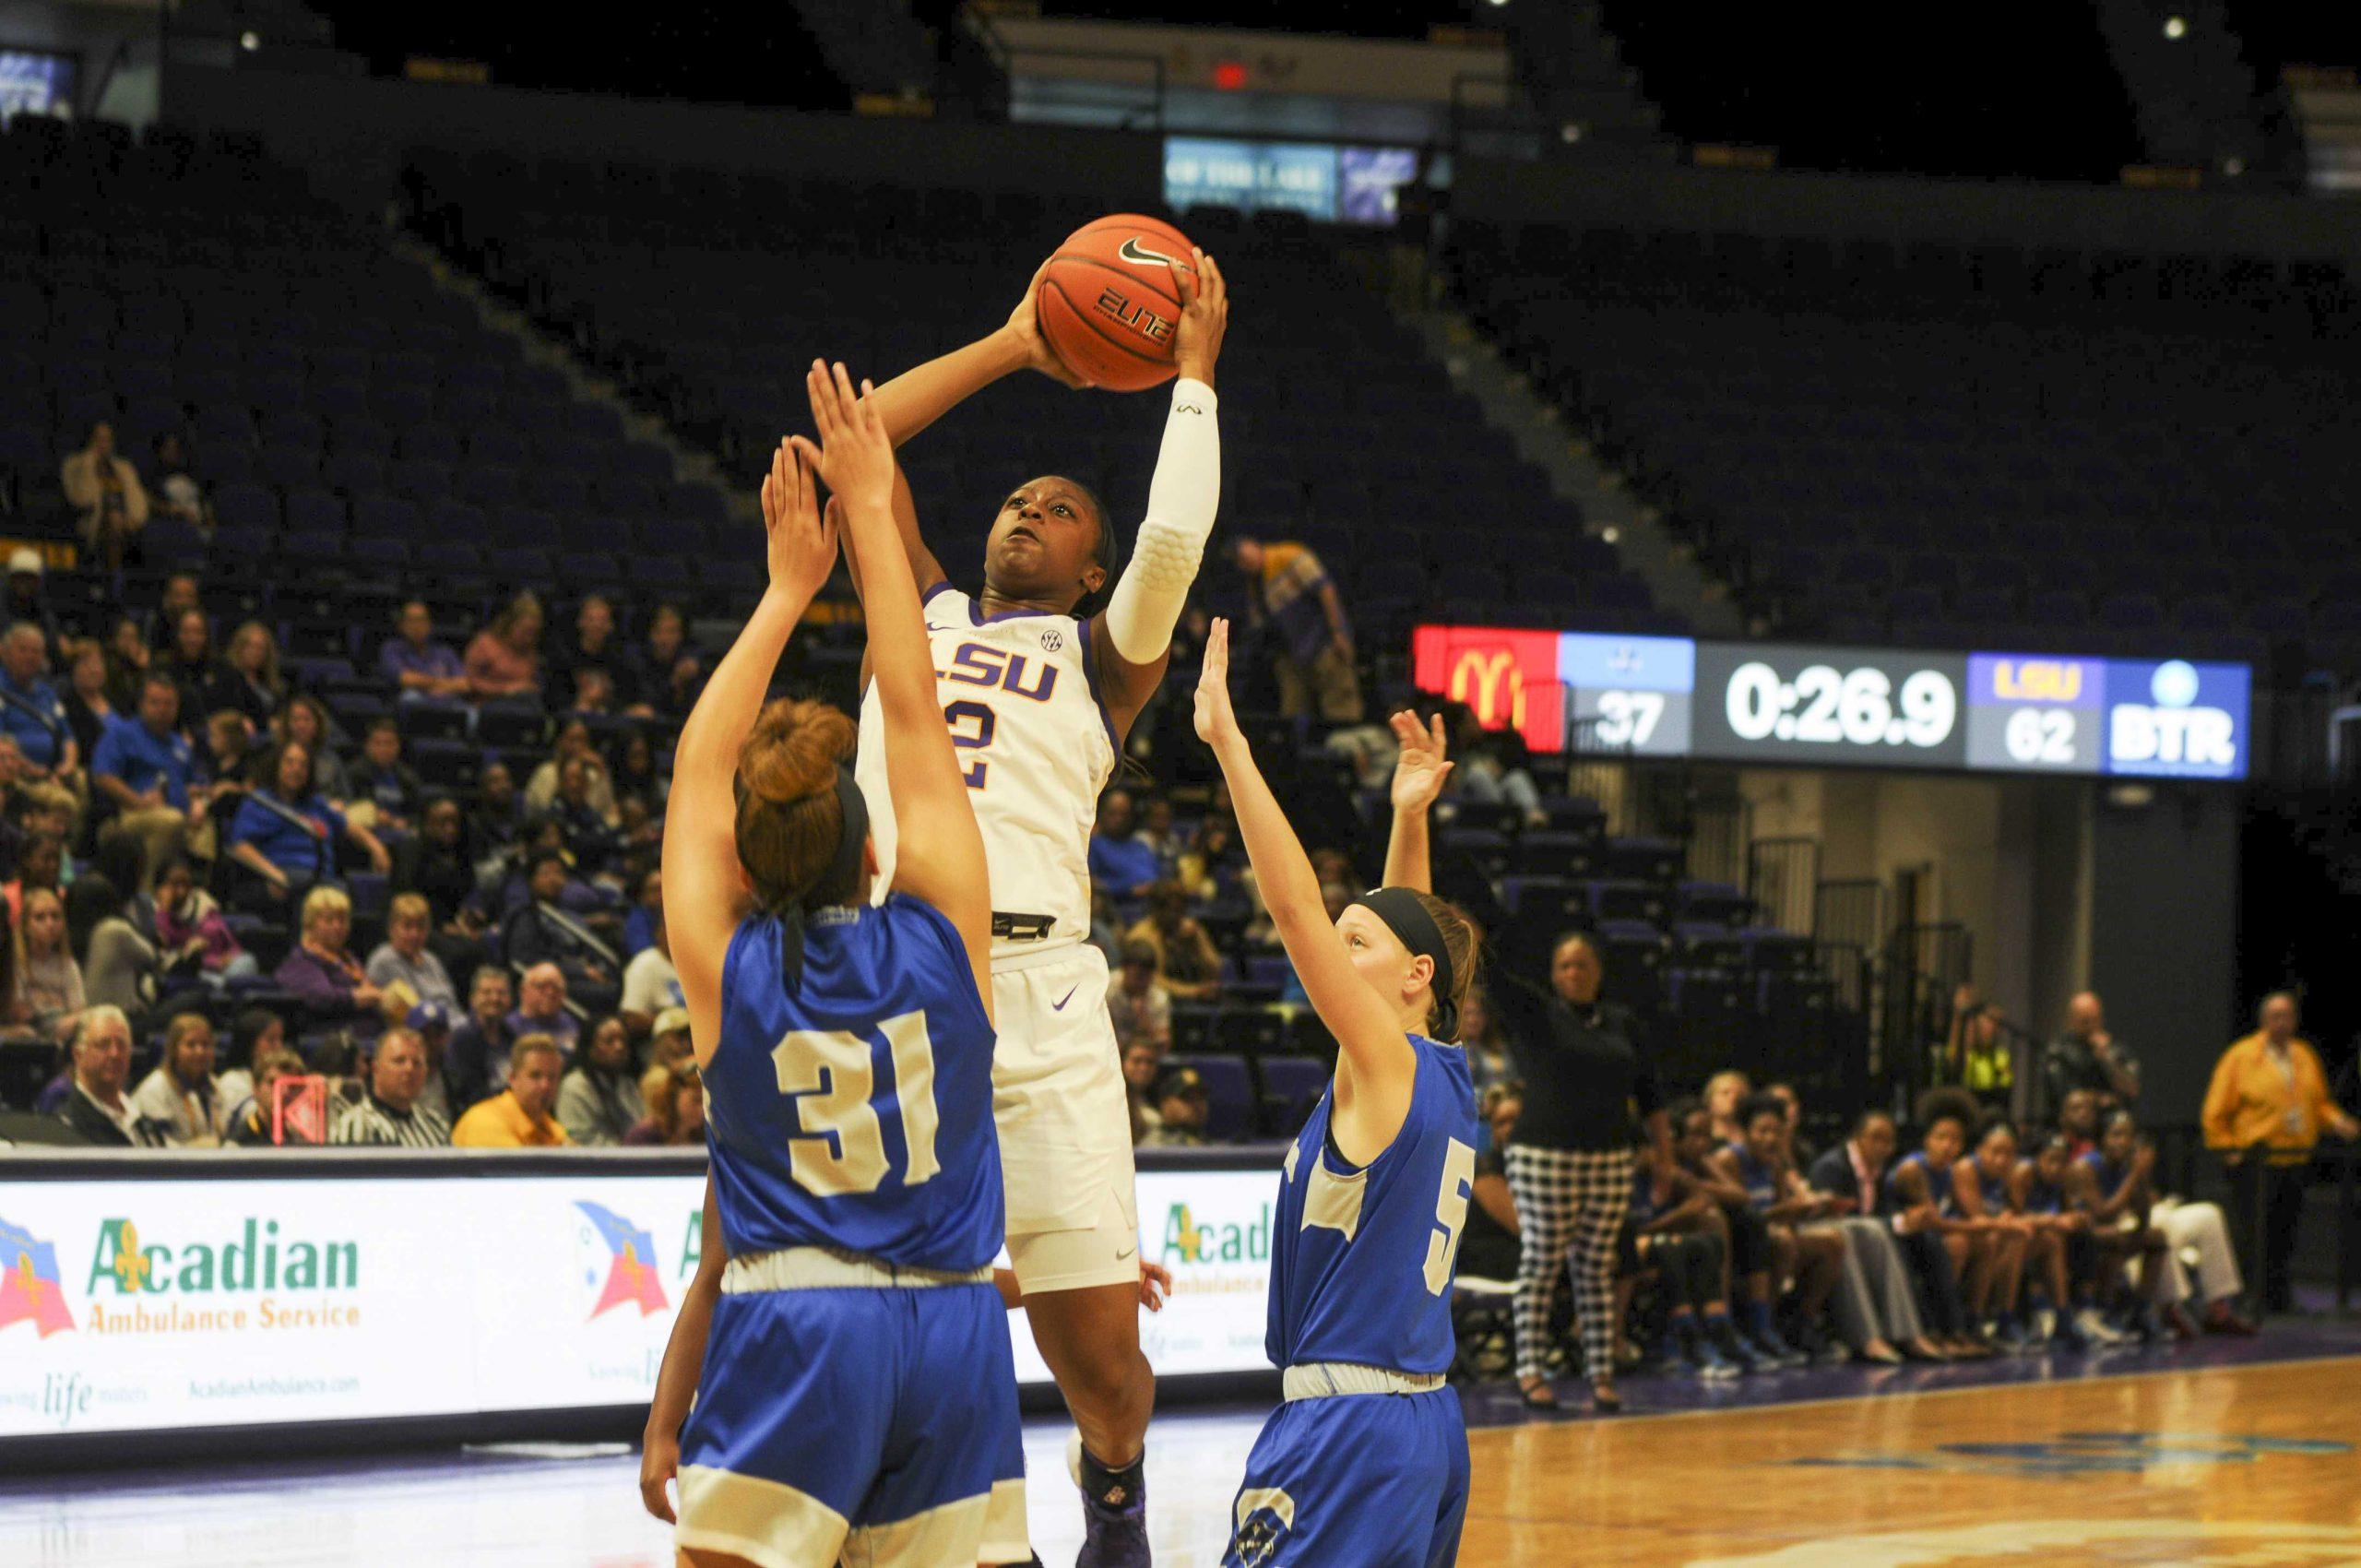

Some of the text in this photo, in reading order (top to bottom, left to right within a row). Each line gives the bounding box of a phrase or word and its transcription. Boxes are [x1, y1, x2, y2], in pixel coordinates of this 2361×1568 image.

[1097, 287, 1175, 343] ELITE
[931, 638, 1060, 704] SU
[1994, 659, 2082, 701] LSU
[1596, 689, 1664, 746] 37
[1726, 661, 1956, 748] 0:26.9
[2006, 707, 2076, 764] 62
[2110, 703, 2236, 765] BTR
[771, 1009, 941, 1197] 31
[1162, 1202, 1268, 1266] Acad
[1423, 1135, 1476, 1297] 5
[86, 1218, 359, 1296] Acadian
[88, 1298, 361, 1334] Ambulance Service
[43, 1372, 92, 1427] life
